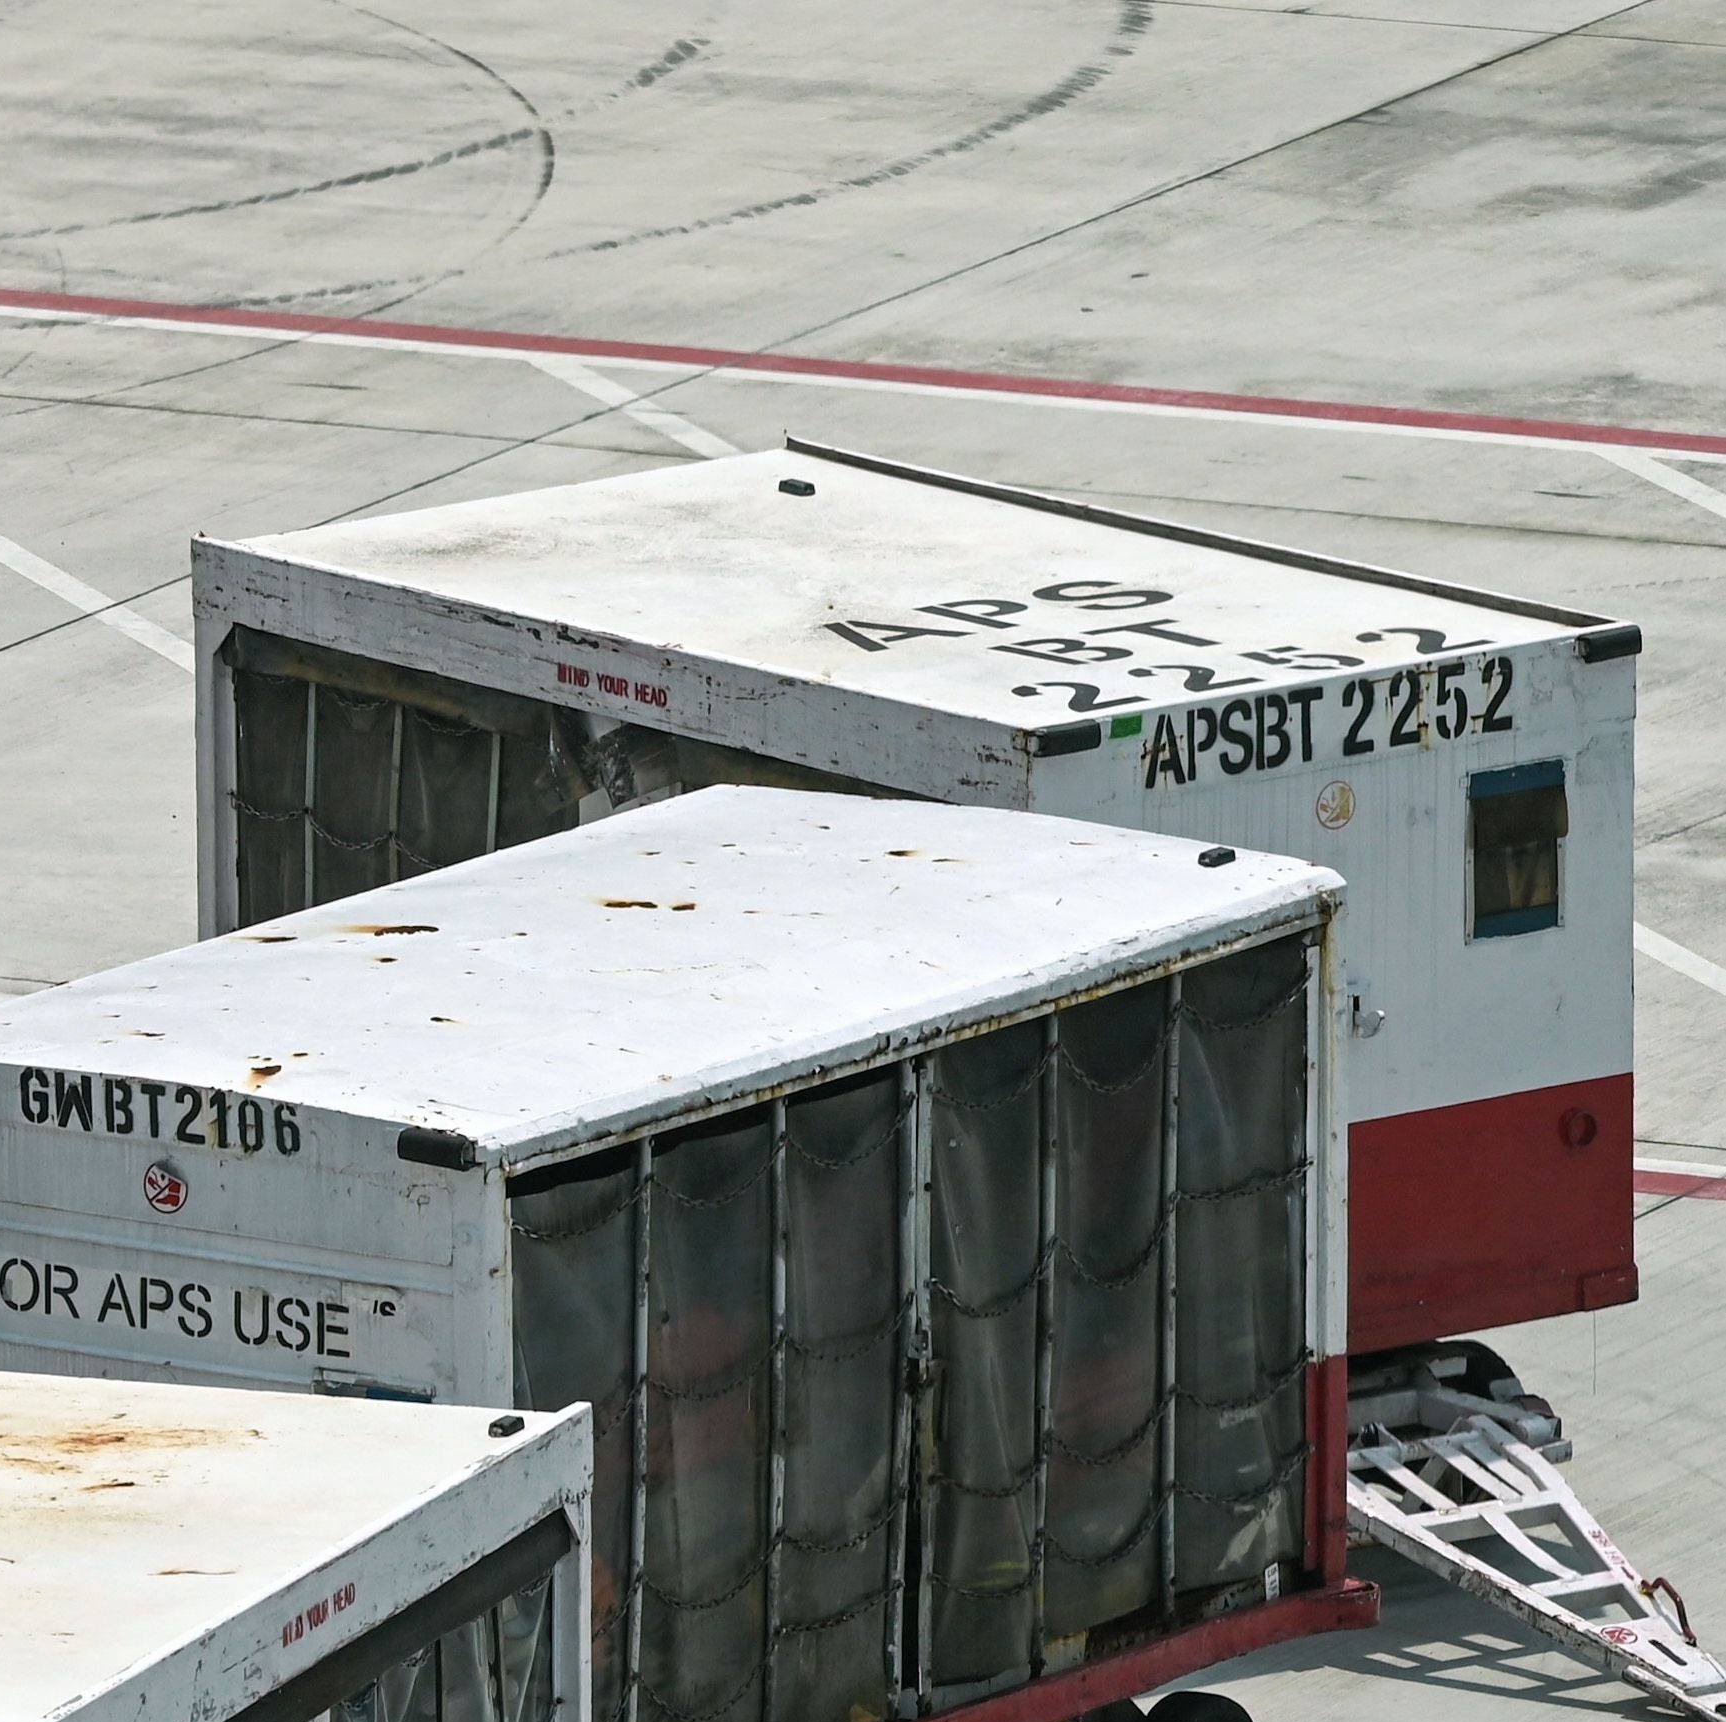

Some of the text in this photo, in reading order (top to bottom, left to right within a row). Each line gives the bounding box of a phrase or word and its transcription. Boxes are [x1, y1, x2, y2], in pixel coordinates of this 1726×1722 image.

[823, 579, 1174, 652] APS
[991, 618, 1220, 666] BT
[558, 662, 667, 708] MIND YOUR HEAD
[1011, 626, 1494, 712] 2252
[1146, 655, 1514, 789] APSBT 2252
[21, 1067, 301, 1156] GWBT2106
[98, 1272, 213, 1338] APS
[234, 1290, 350, 1358] USE
[333, 1582, 355, 1615] HEAD
